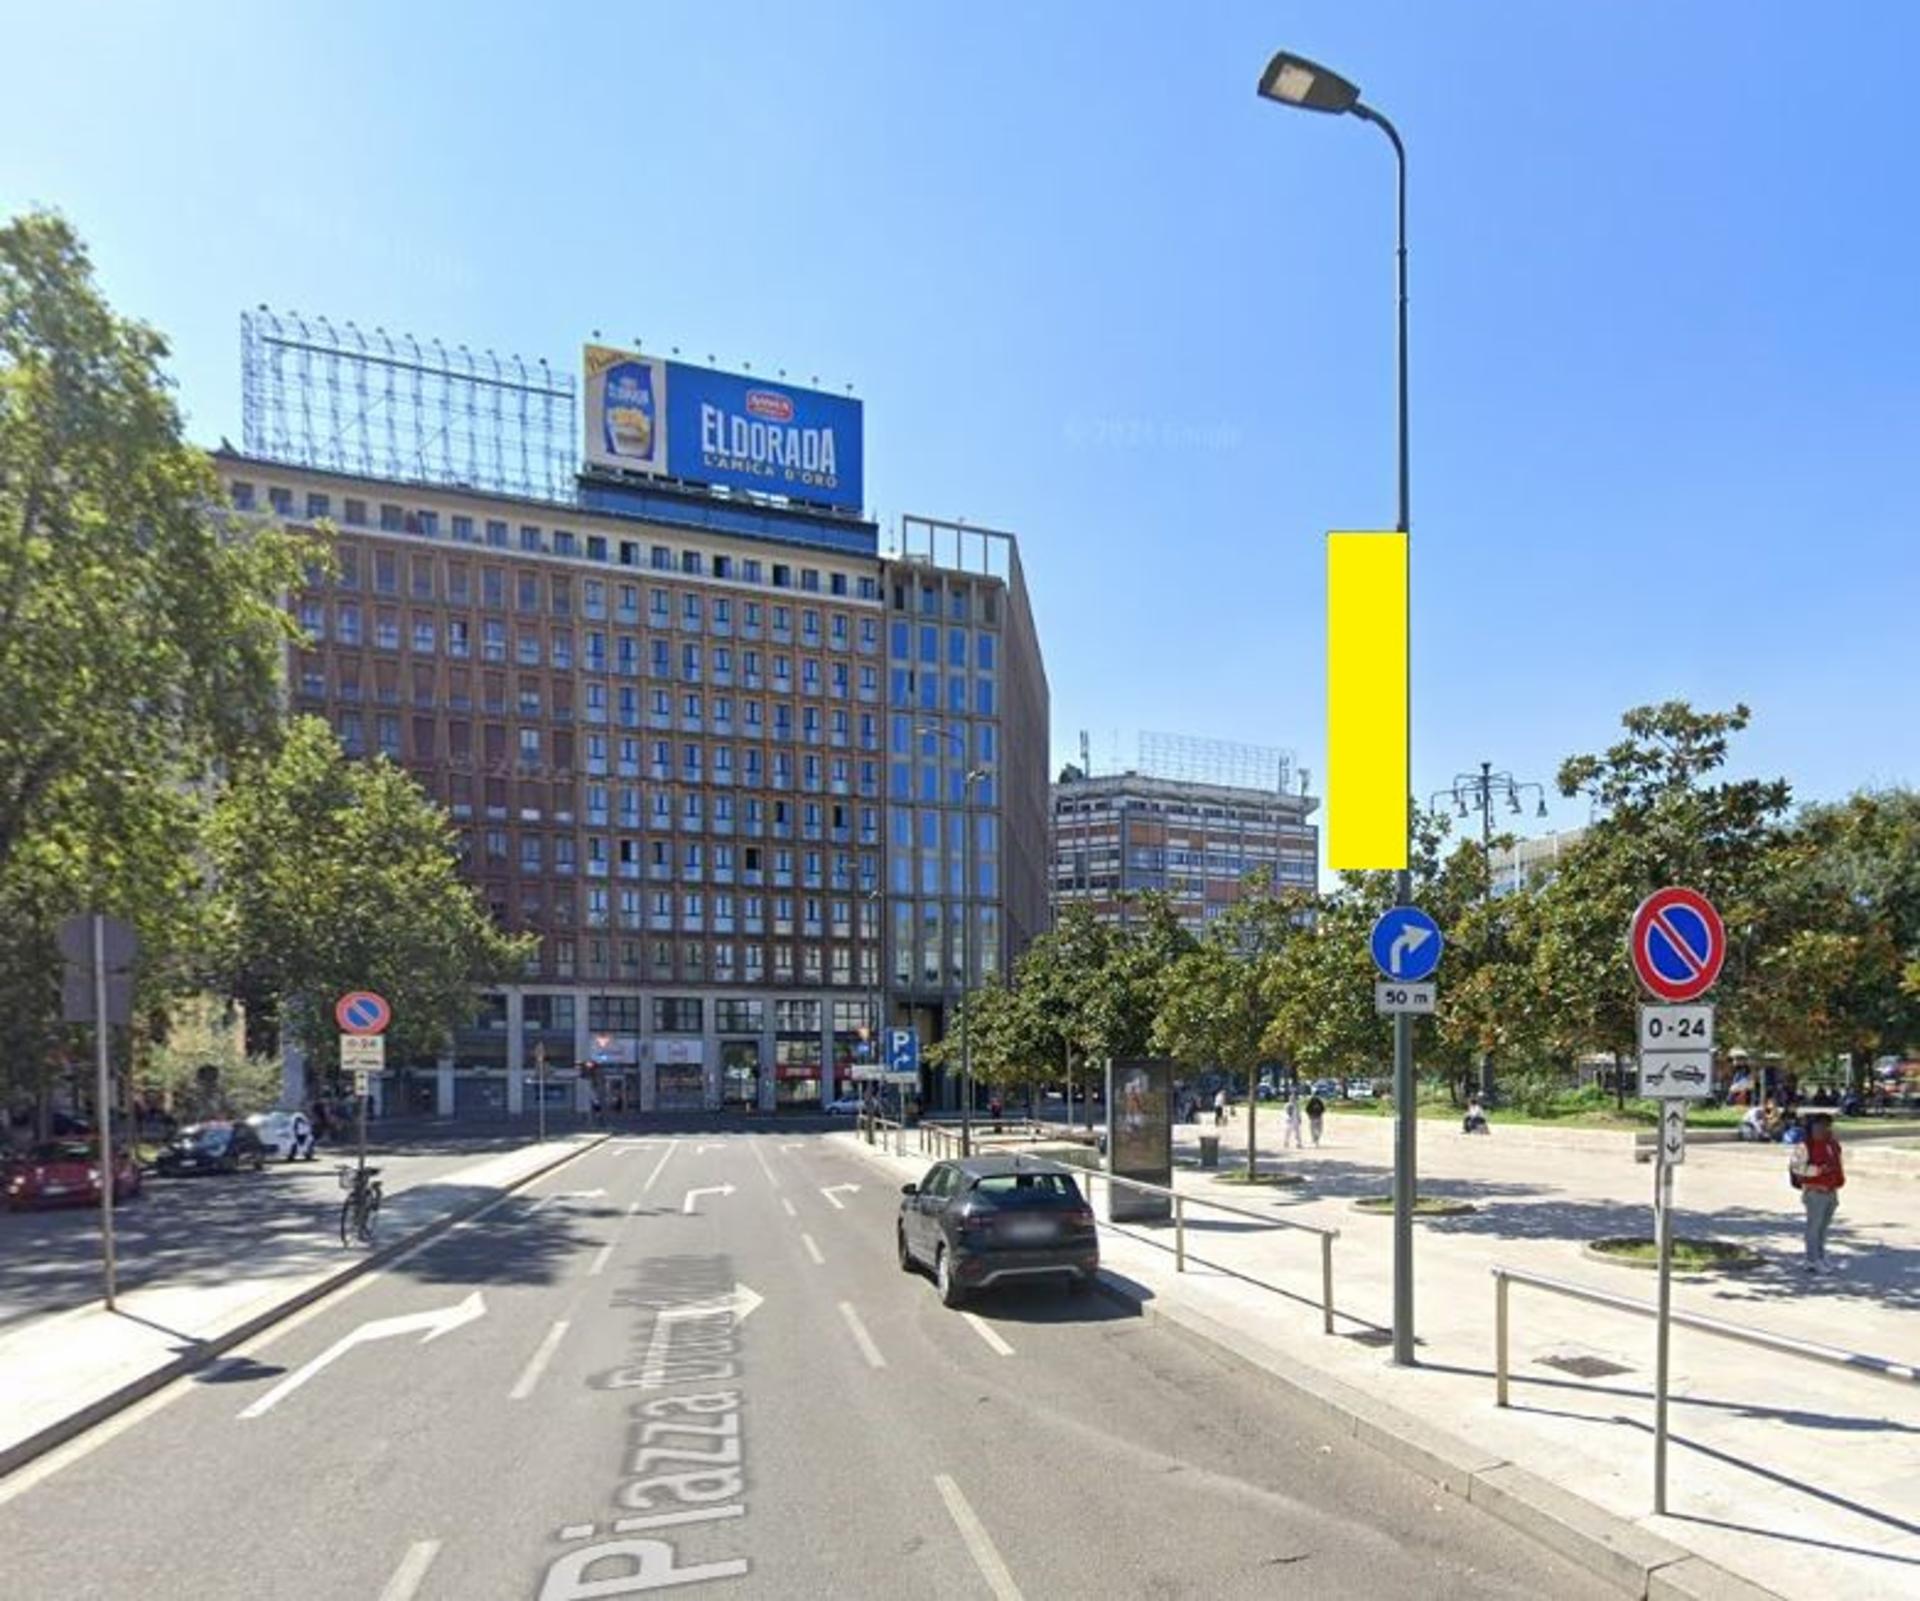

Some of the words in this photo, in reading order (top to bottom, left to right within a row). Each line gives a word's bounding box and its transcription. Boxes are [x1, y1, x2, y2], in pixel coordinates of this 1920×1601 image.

[701, 402, 836, 476] ELDORADA
[704, 454, 774, 477] L'AMICA
[1385, 989, 1408, 1005] 50
[1414, 994, 1428, 1004] m
[893, 1031, 910, 1053] P
